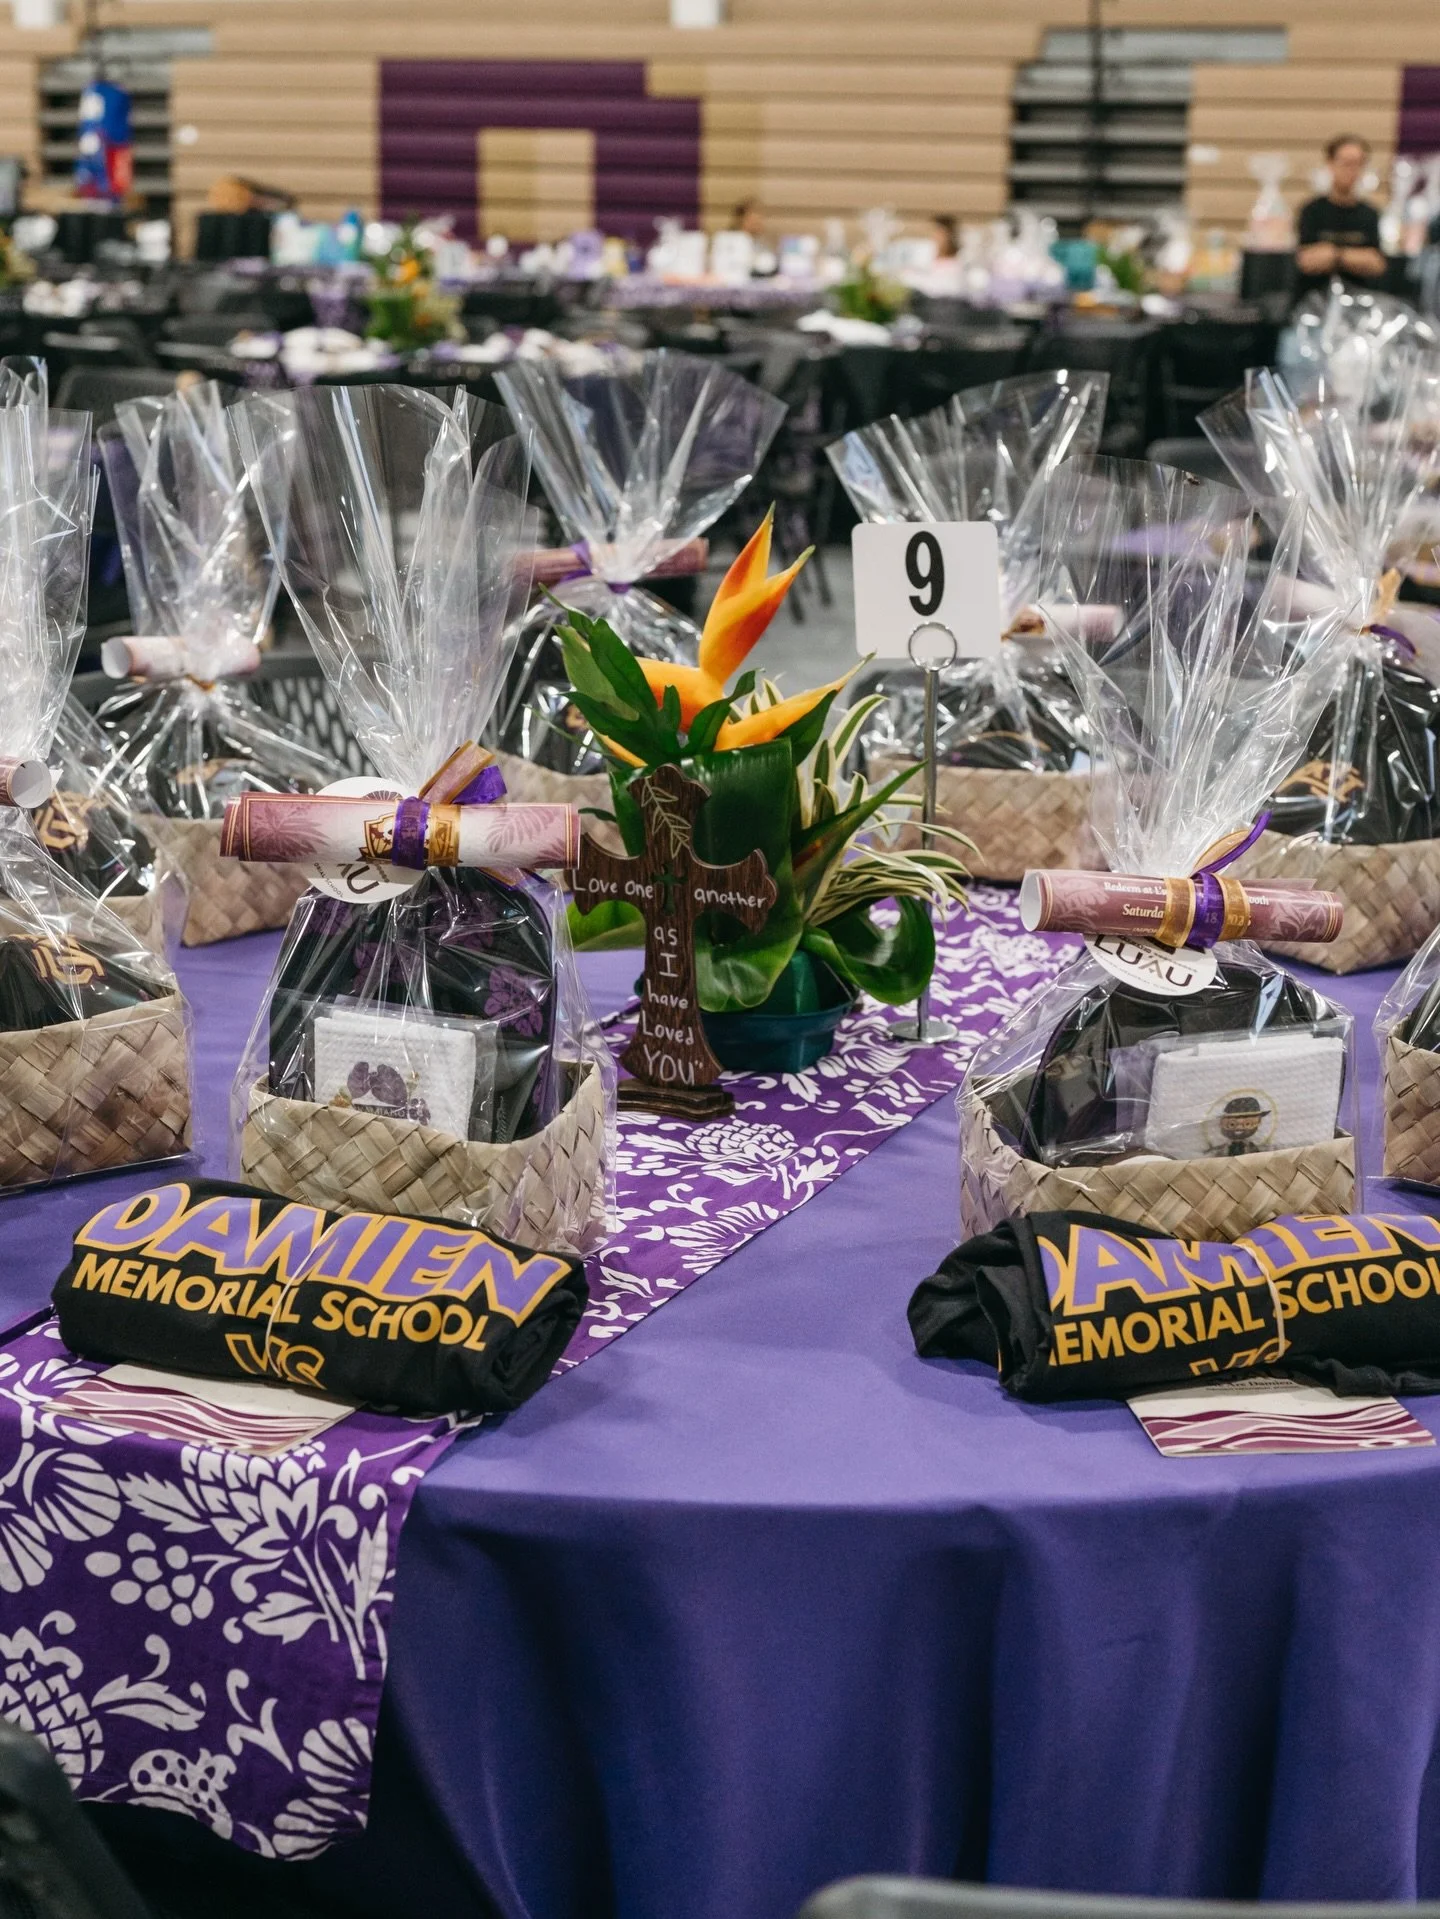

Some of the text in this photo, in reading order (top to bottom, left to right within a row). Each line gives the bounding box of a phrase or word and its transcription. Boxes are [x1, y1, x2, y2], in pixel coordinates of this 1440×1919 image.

[905, 530, 945, 617] 9
[572, 869, 618, 895] Love
[694, 886, 767, 909] another
[1248, 895, 1269, 905] ooth
[1122, 903, 1165, 919] Saturda
[654, 926, 678, 946] as
[659, 953, 679, 978] I
[647, 978, 689, 1010] have
[642, 1010, 694, 1046] Loved
[73, 1182, 573, 1328] DAMIEN
[71, 1252, 490, 1351] MEMORIAL SCHOOL
[1049, 1294, 1265, 1367] EMORIAL
